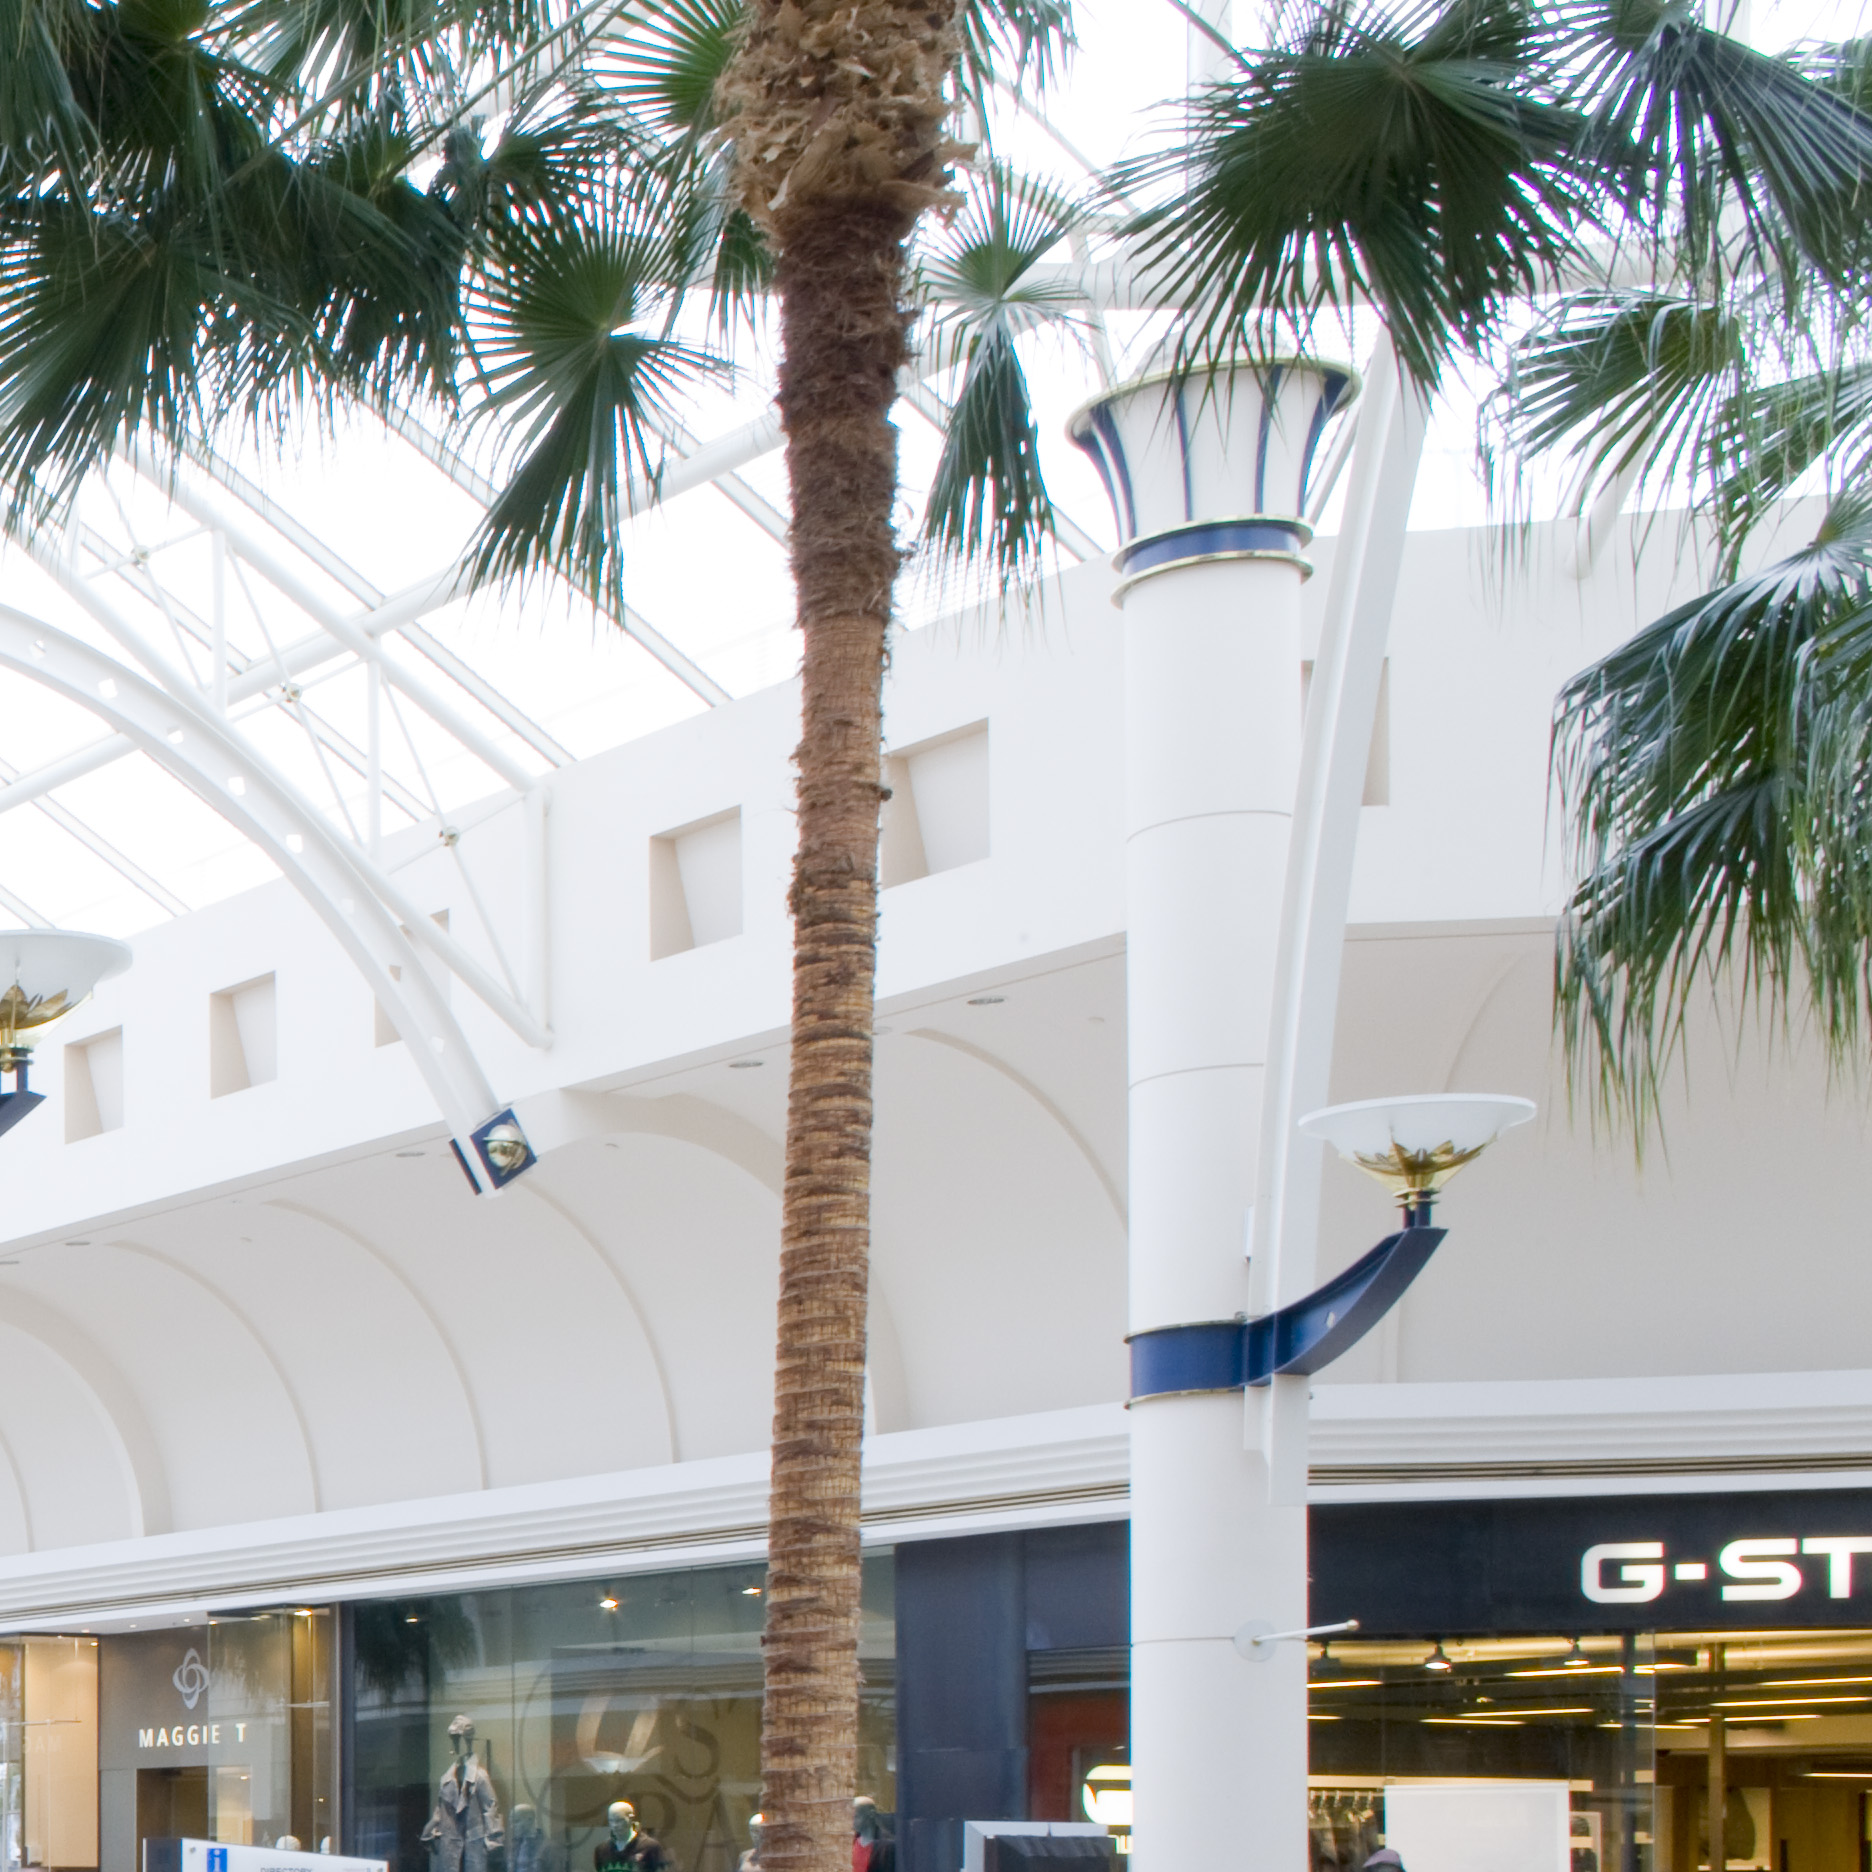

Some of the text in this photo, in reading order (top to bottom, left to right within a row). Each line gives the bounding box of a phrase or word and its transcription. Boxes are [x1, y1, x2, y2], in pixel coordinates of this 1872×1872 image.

[1581, 1536, 1872, 1604] G-ST
[139, 1723, 247, 1748] MAGGIE T
